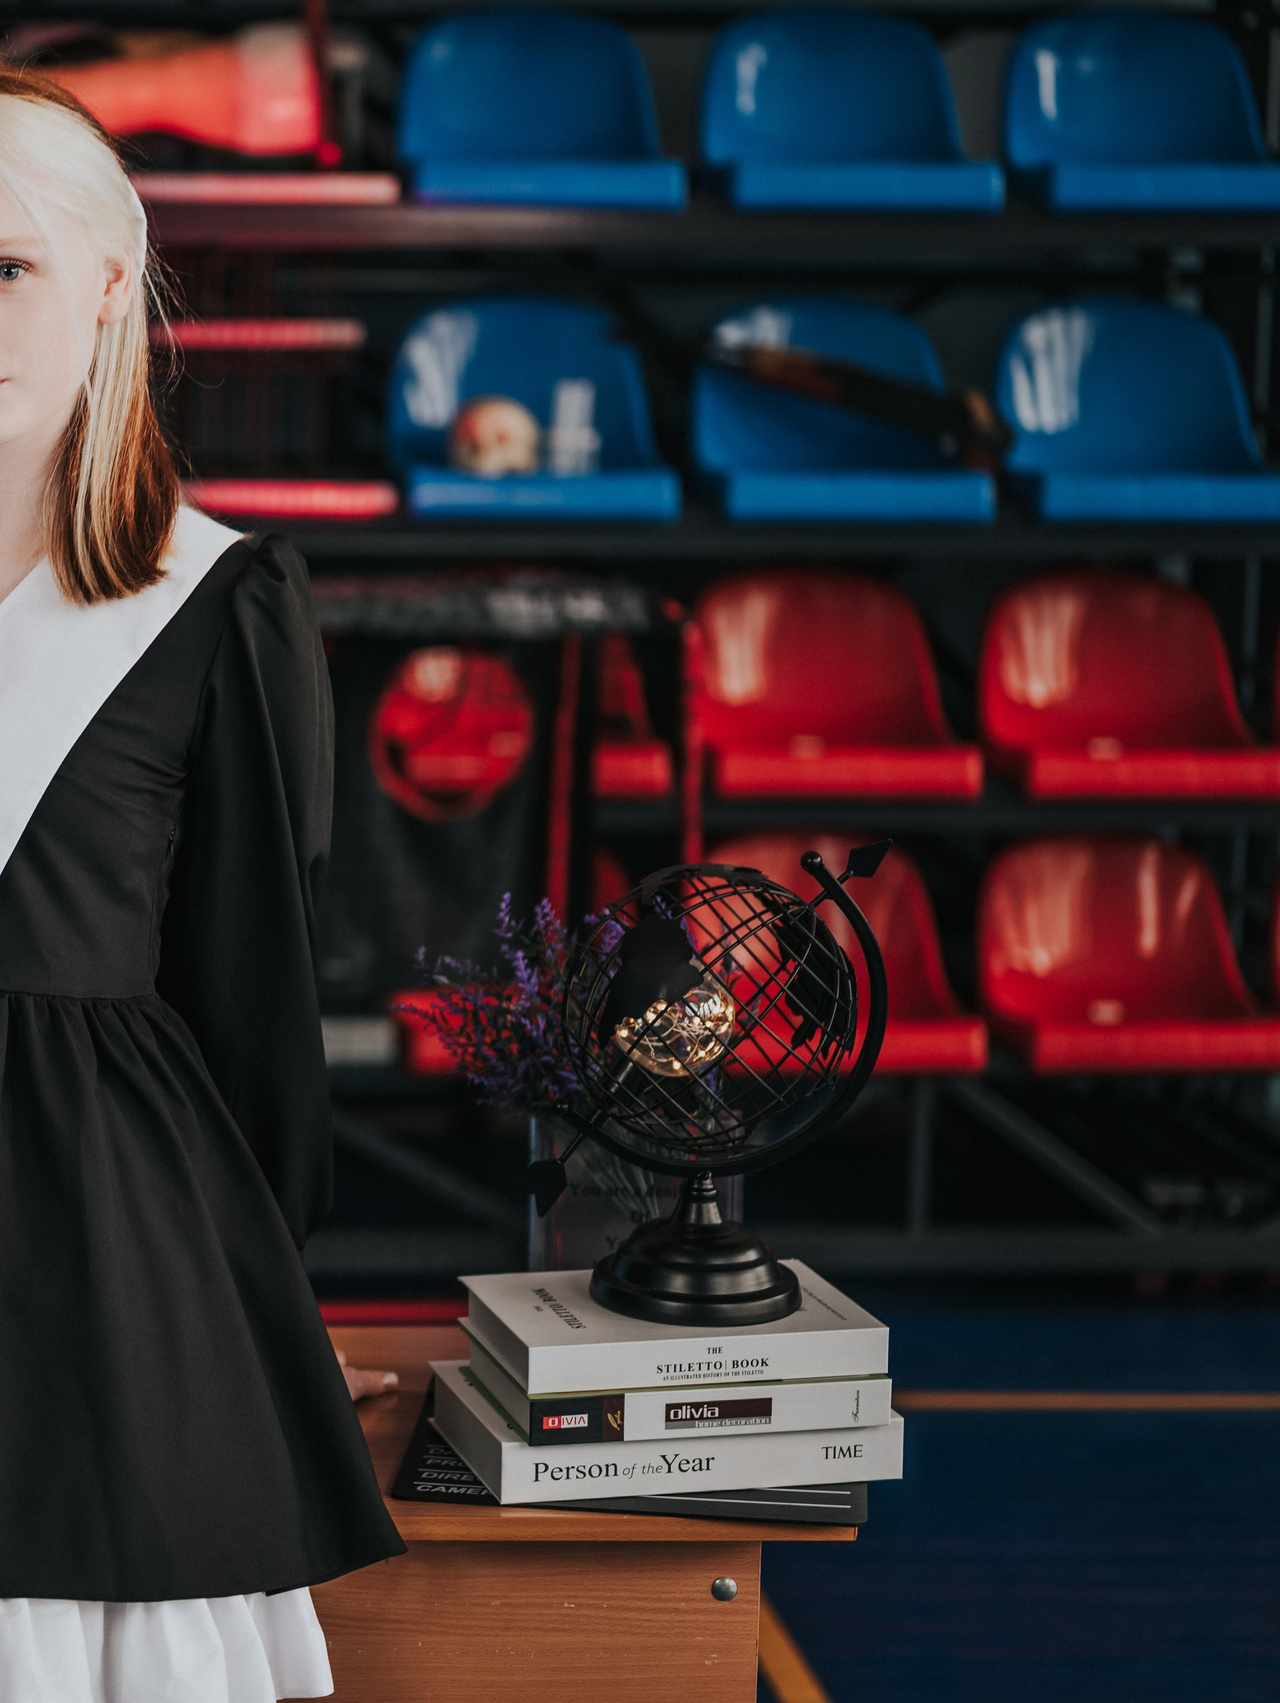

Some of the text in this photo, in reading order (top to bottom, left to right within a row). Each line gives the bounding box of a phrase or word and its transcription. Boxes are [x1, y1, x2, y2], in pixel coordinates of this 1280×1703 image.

[549, 1303, 586, 1329] STILETTO
[706, 1346, 723, 1355] THE
[656, 1357, 770, 1374] STILETTO BOOK
[669, 1404, 720, 1420] olivia
[695, 1417, 770, 1428] home decoration
[821, 1444, 863, 1460] TIME
[532, 1453, 716, 1483] Person of the Year
[421, 1471, 479, 1482] DIRE
[416, 1484, 494, 1496] CAMER
